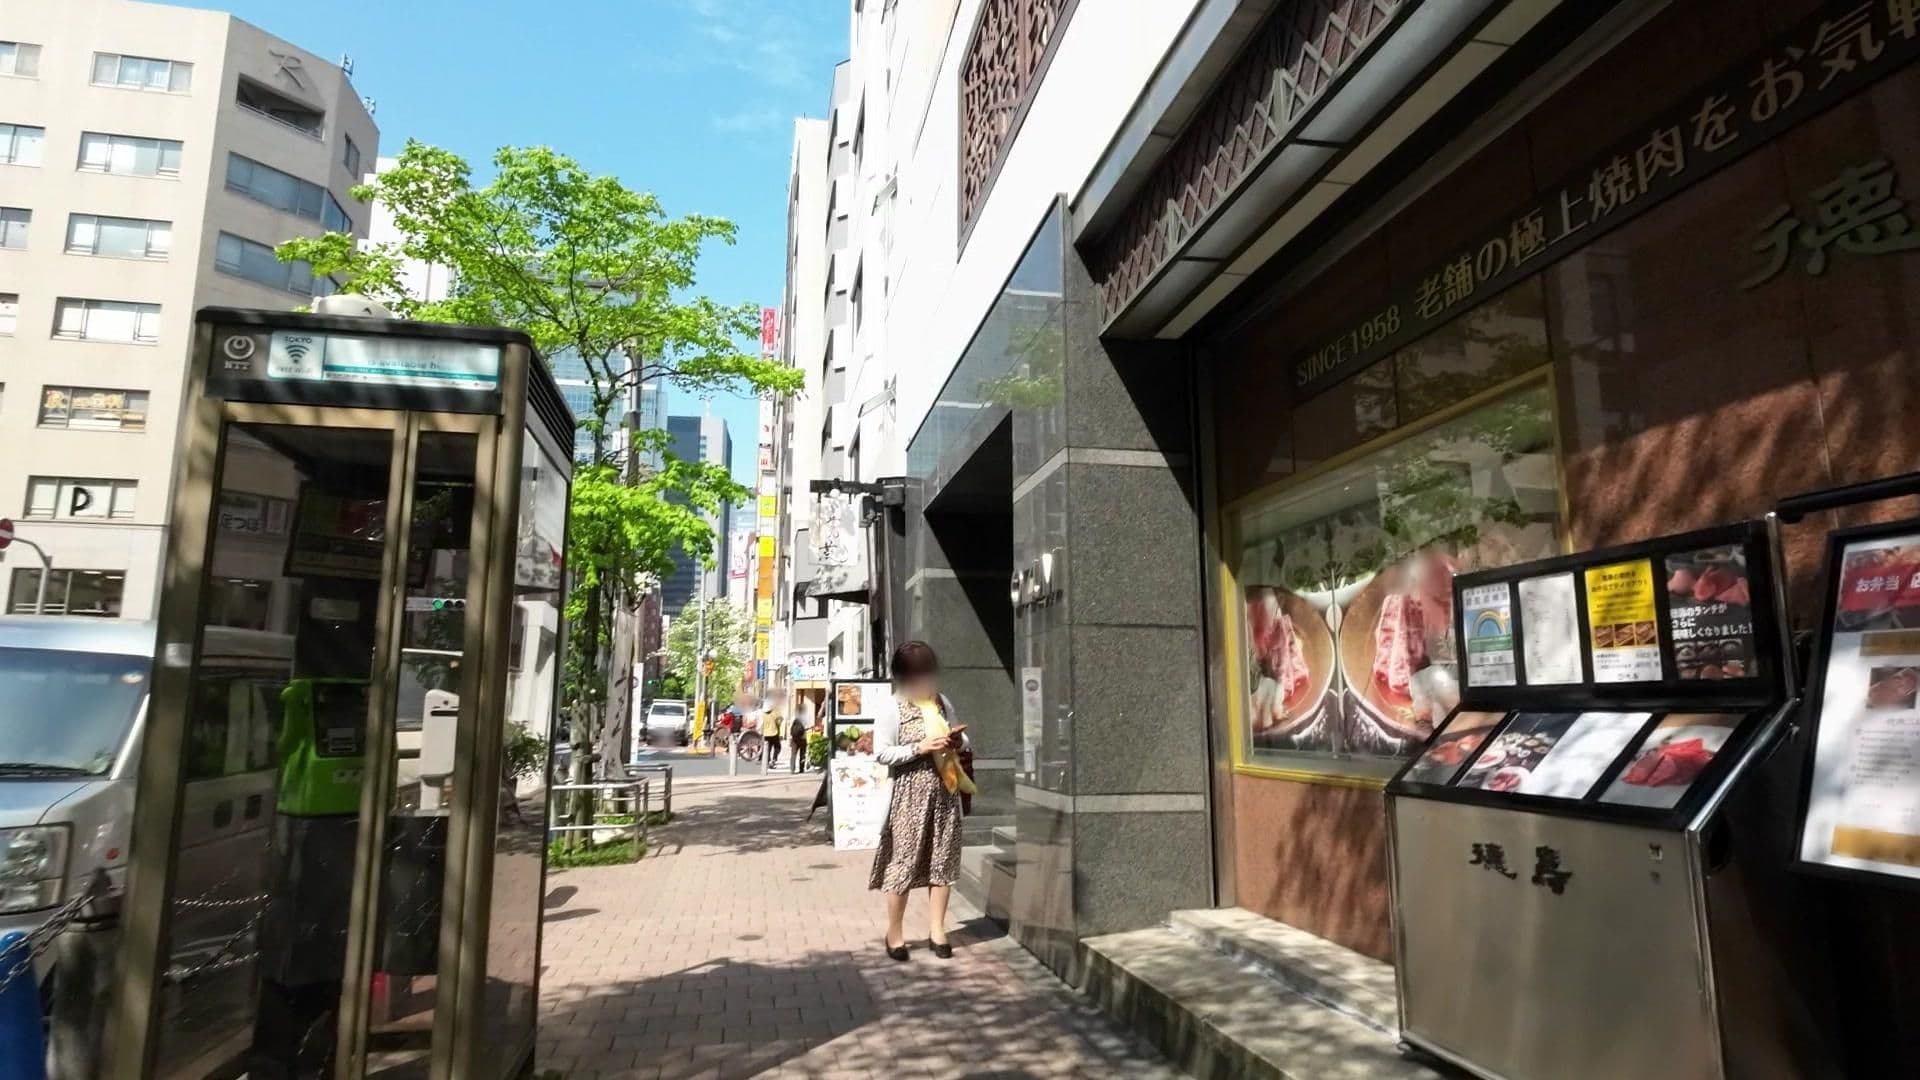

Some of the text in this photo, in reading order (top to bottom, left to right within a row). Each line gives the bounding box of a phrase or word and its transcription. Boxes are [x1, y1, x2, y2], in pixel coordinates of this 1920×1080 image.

[284, 335, 313, 345] TOKYO
[1296, 334, 1348, 387] SINCE
[1351, 304, 1401, 358] 1958
[223, 360, 251, 371] NTT
[69, 486, 93, 517] P
